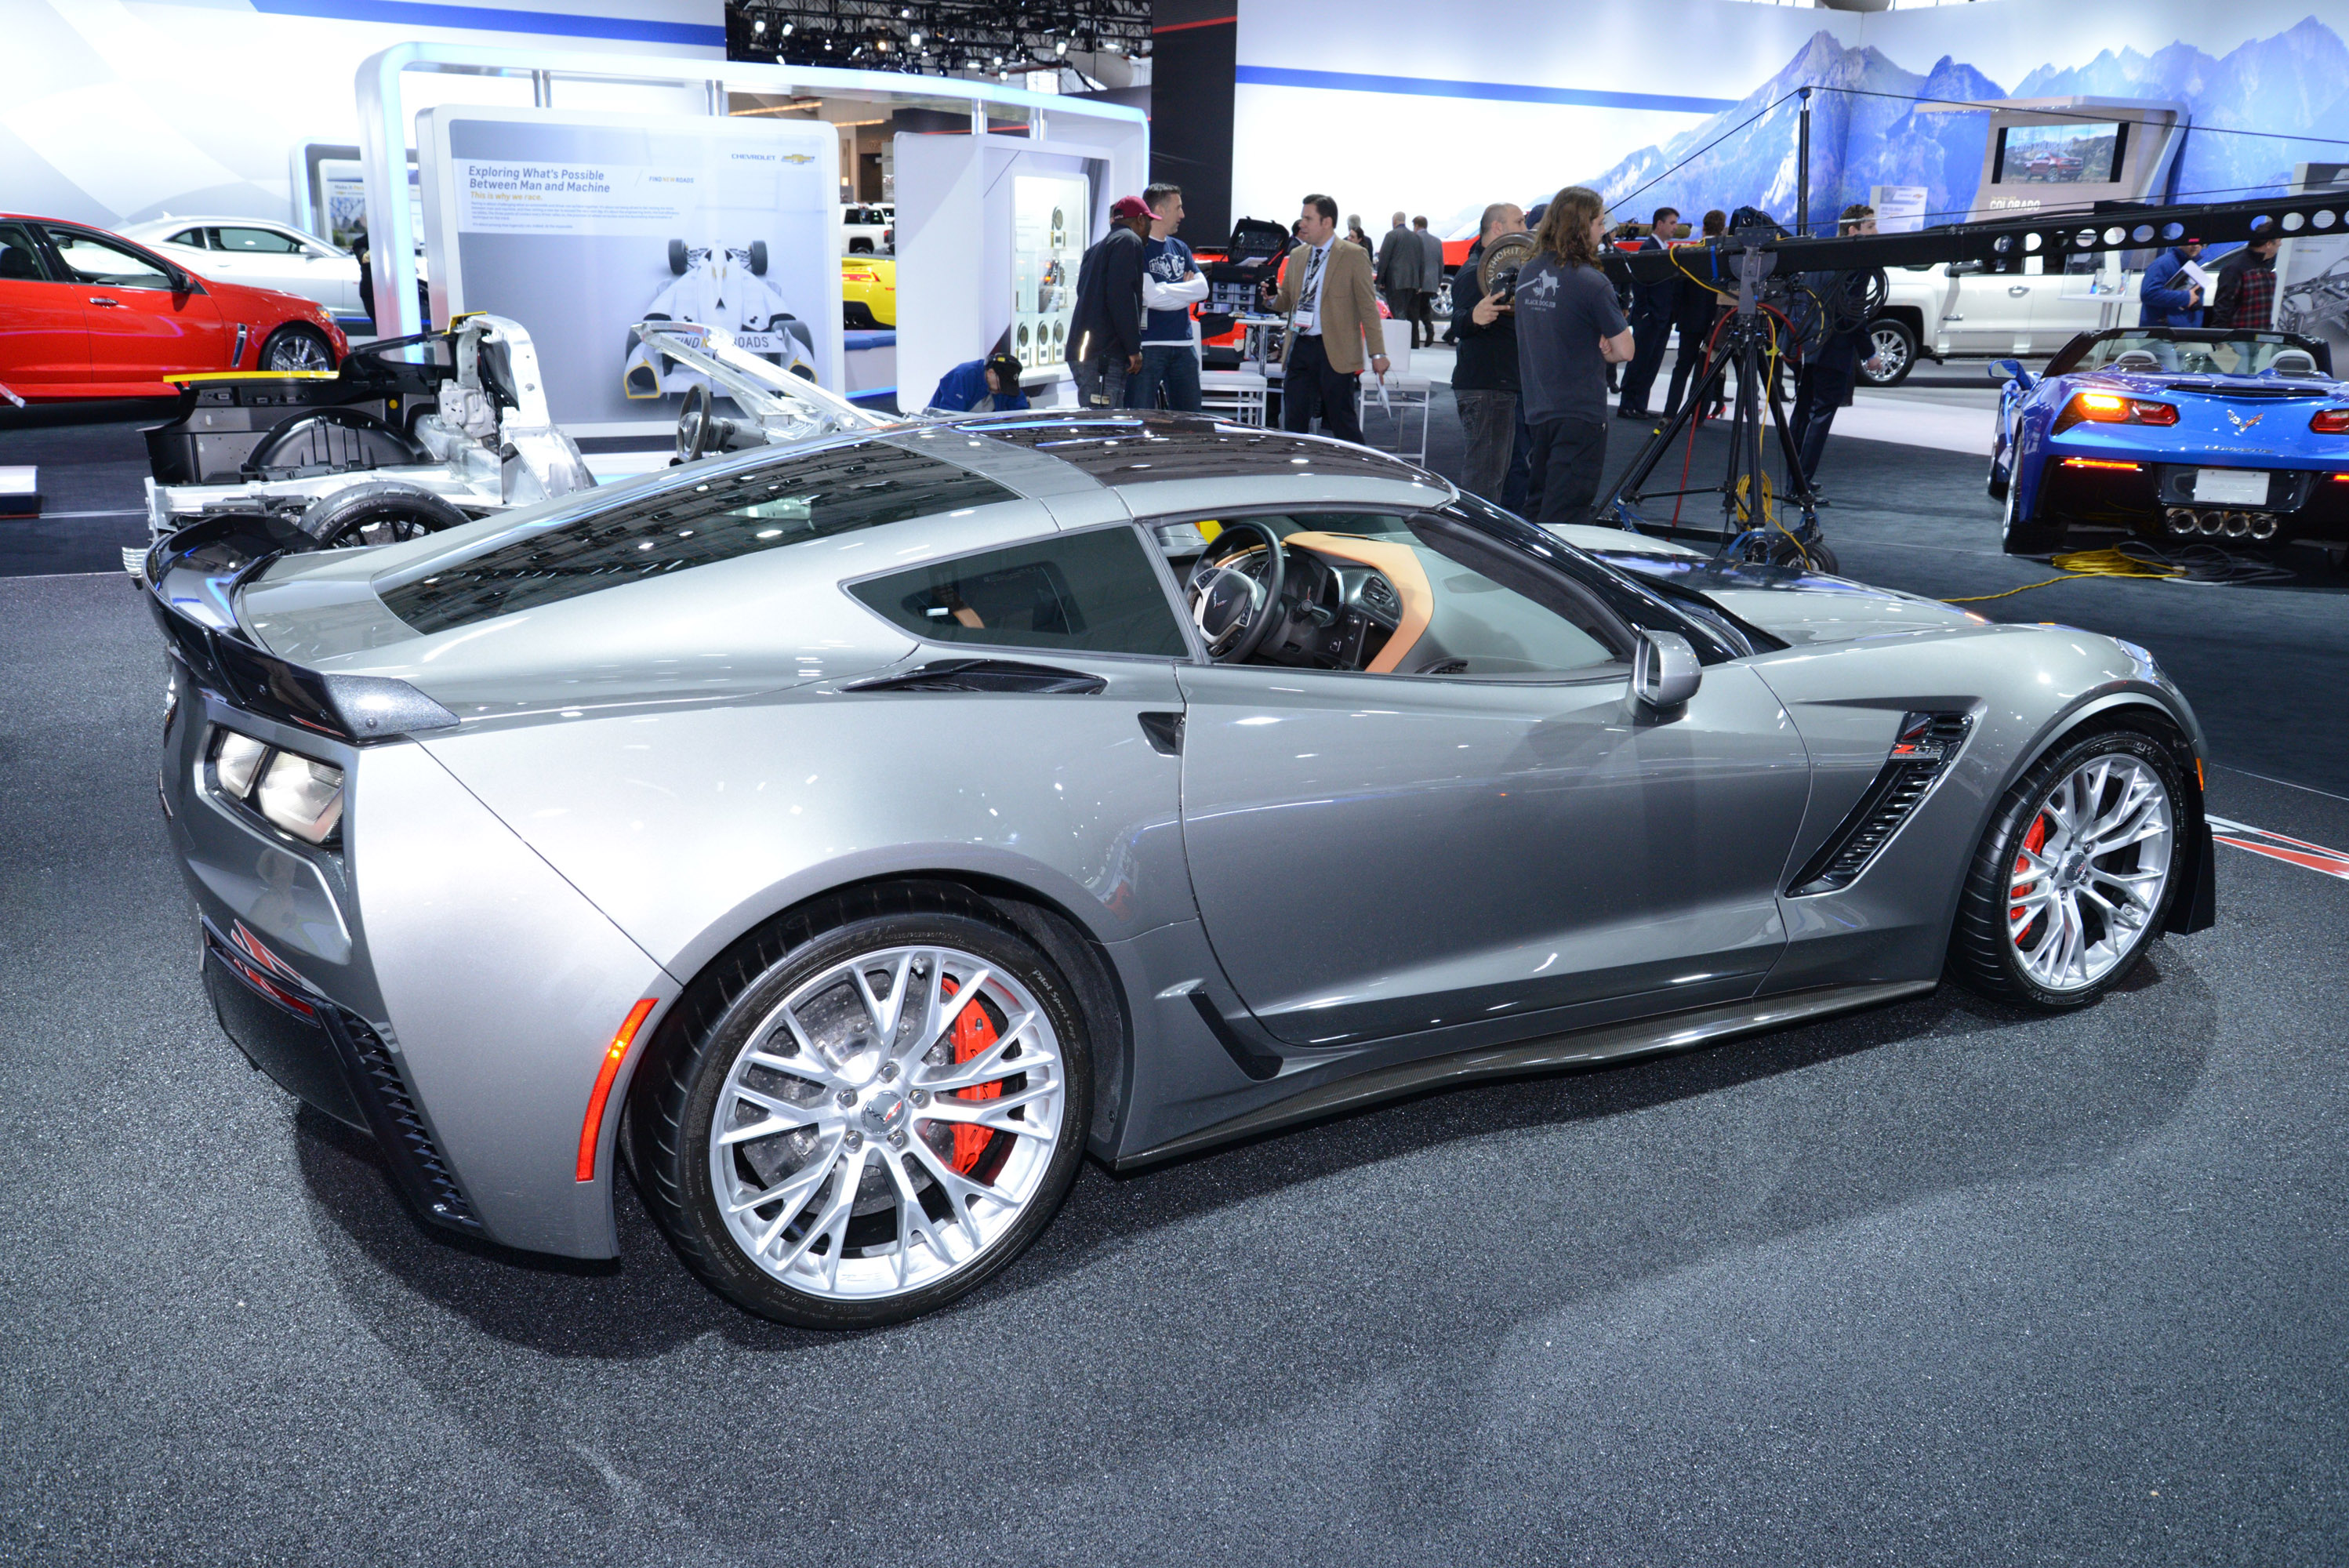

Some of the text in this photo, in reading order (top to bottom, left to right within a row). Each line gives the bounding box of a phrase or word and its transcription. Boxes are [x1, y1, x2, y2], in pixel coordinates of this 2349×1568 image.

[469, 165, 604, 180] Exploring What's Possible
[470, 179, 610, 193] Between Man and Machine
[495, 192, 510, 201] why
[1989, 200, 2041, 212] COLORADO
[1032, 968, 1053, 991] Pilot
[1050, 991, 1069, 1018] Sport
